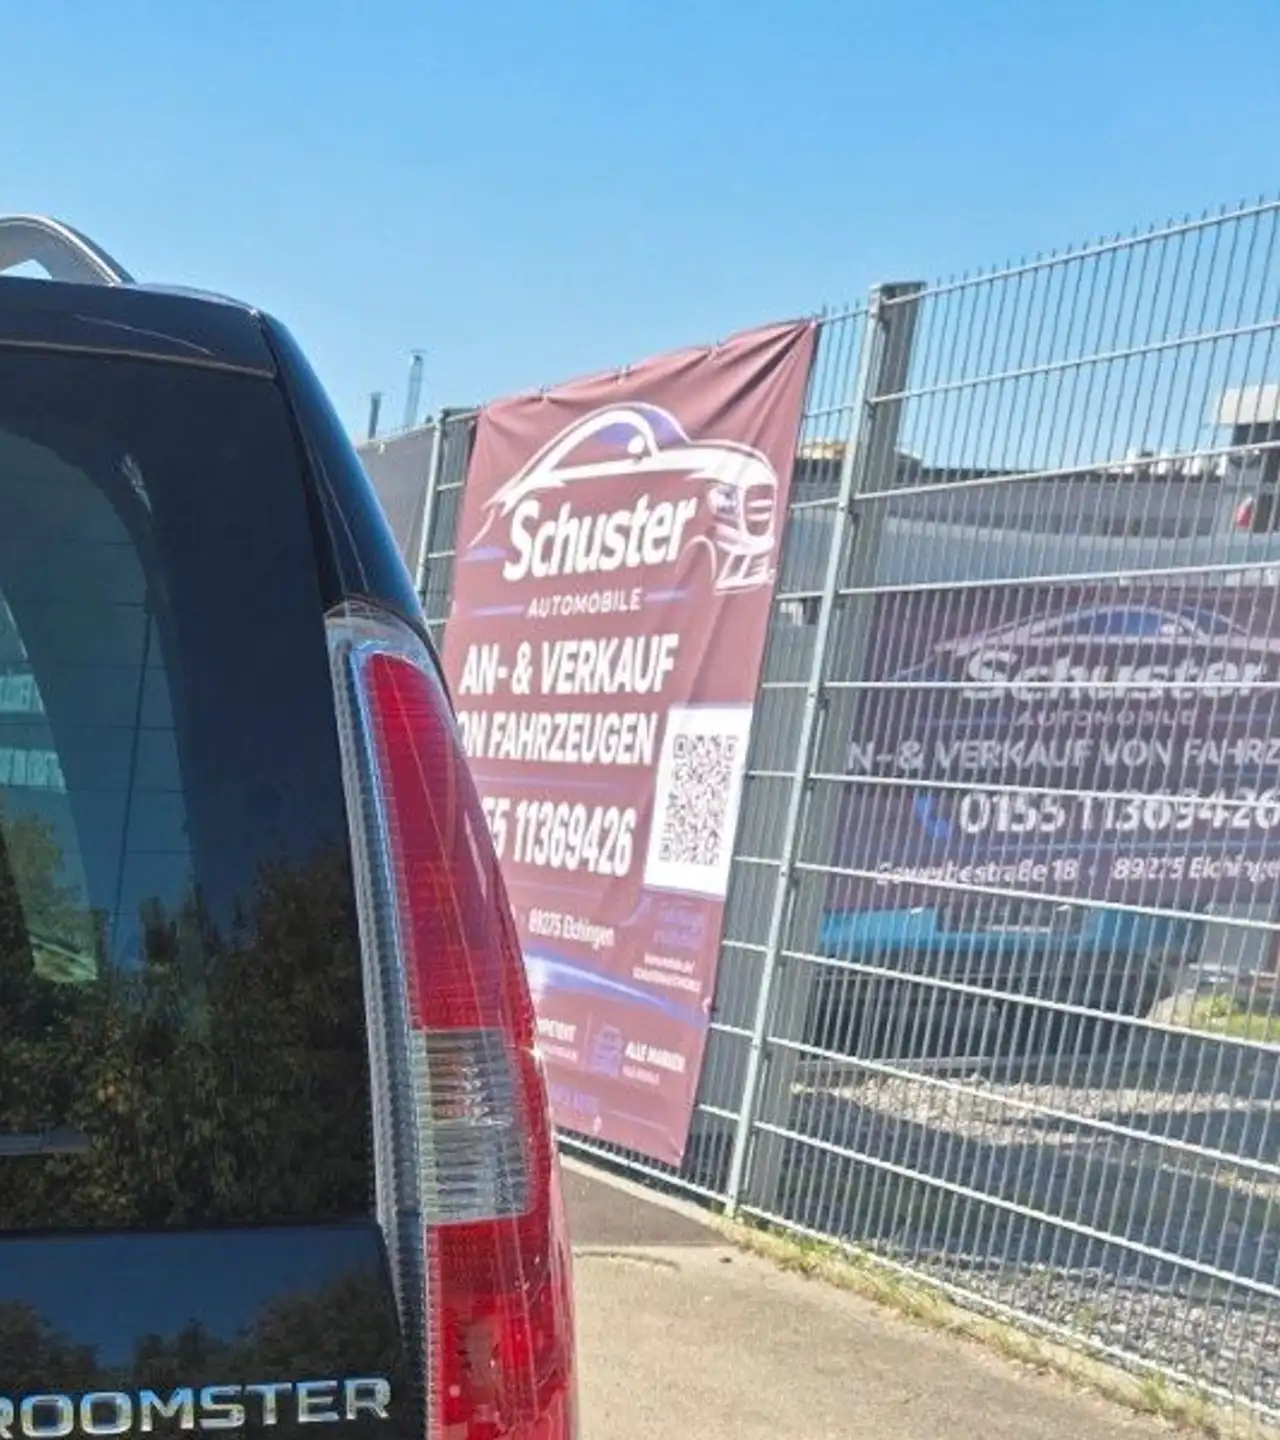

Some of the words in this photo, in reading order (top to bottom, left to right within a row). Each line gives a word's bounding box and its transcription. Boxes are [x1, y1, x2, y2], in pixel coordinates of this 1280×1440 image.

[503, 495, 696, 581] Schuster
[526, 588, 644, 619] AUTOMOBILE
[460, 645, 508, 694] AN-
[511, 642, 534, 694] &
[540, 634, 680, 694] VERKAUF
[962, 651, 1268, 700] Schuster
[457, 711, 487, 757] ON
[488, 711, 659, 766] FAHRZEUGEN
[847, 740, 895, 770] N-
[897, 740, 924, 769] &
[935, 739, 1094, 769] VERKAUF
[1101, 738, 1173, 767] VON
[960, 791, 1066, 833] 0155
[513, 800, 638, 877] 11369426
